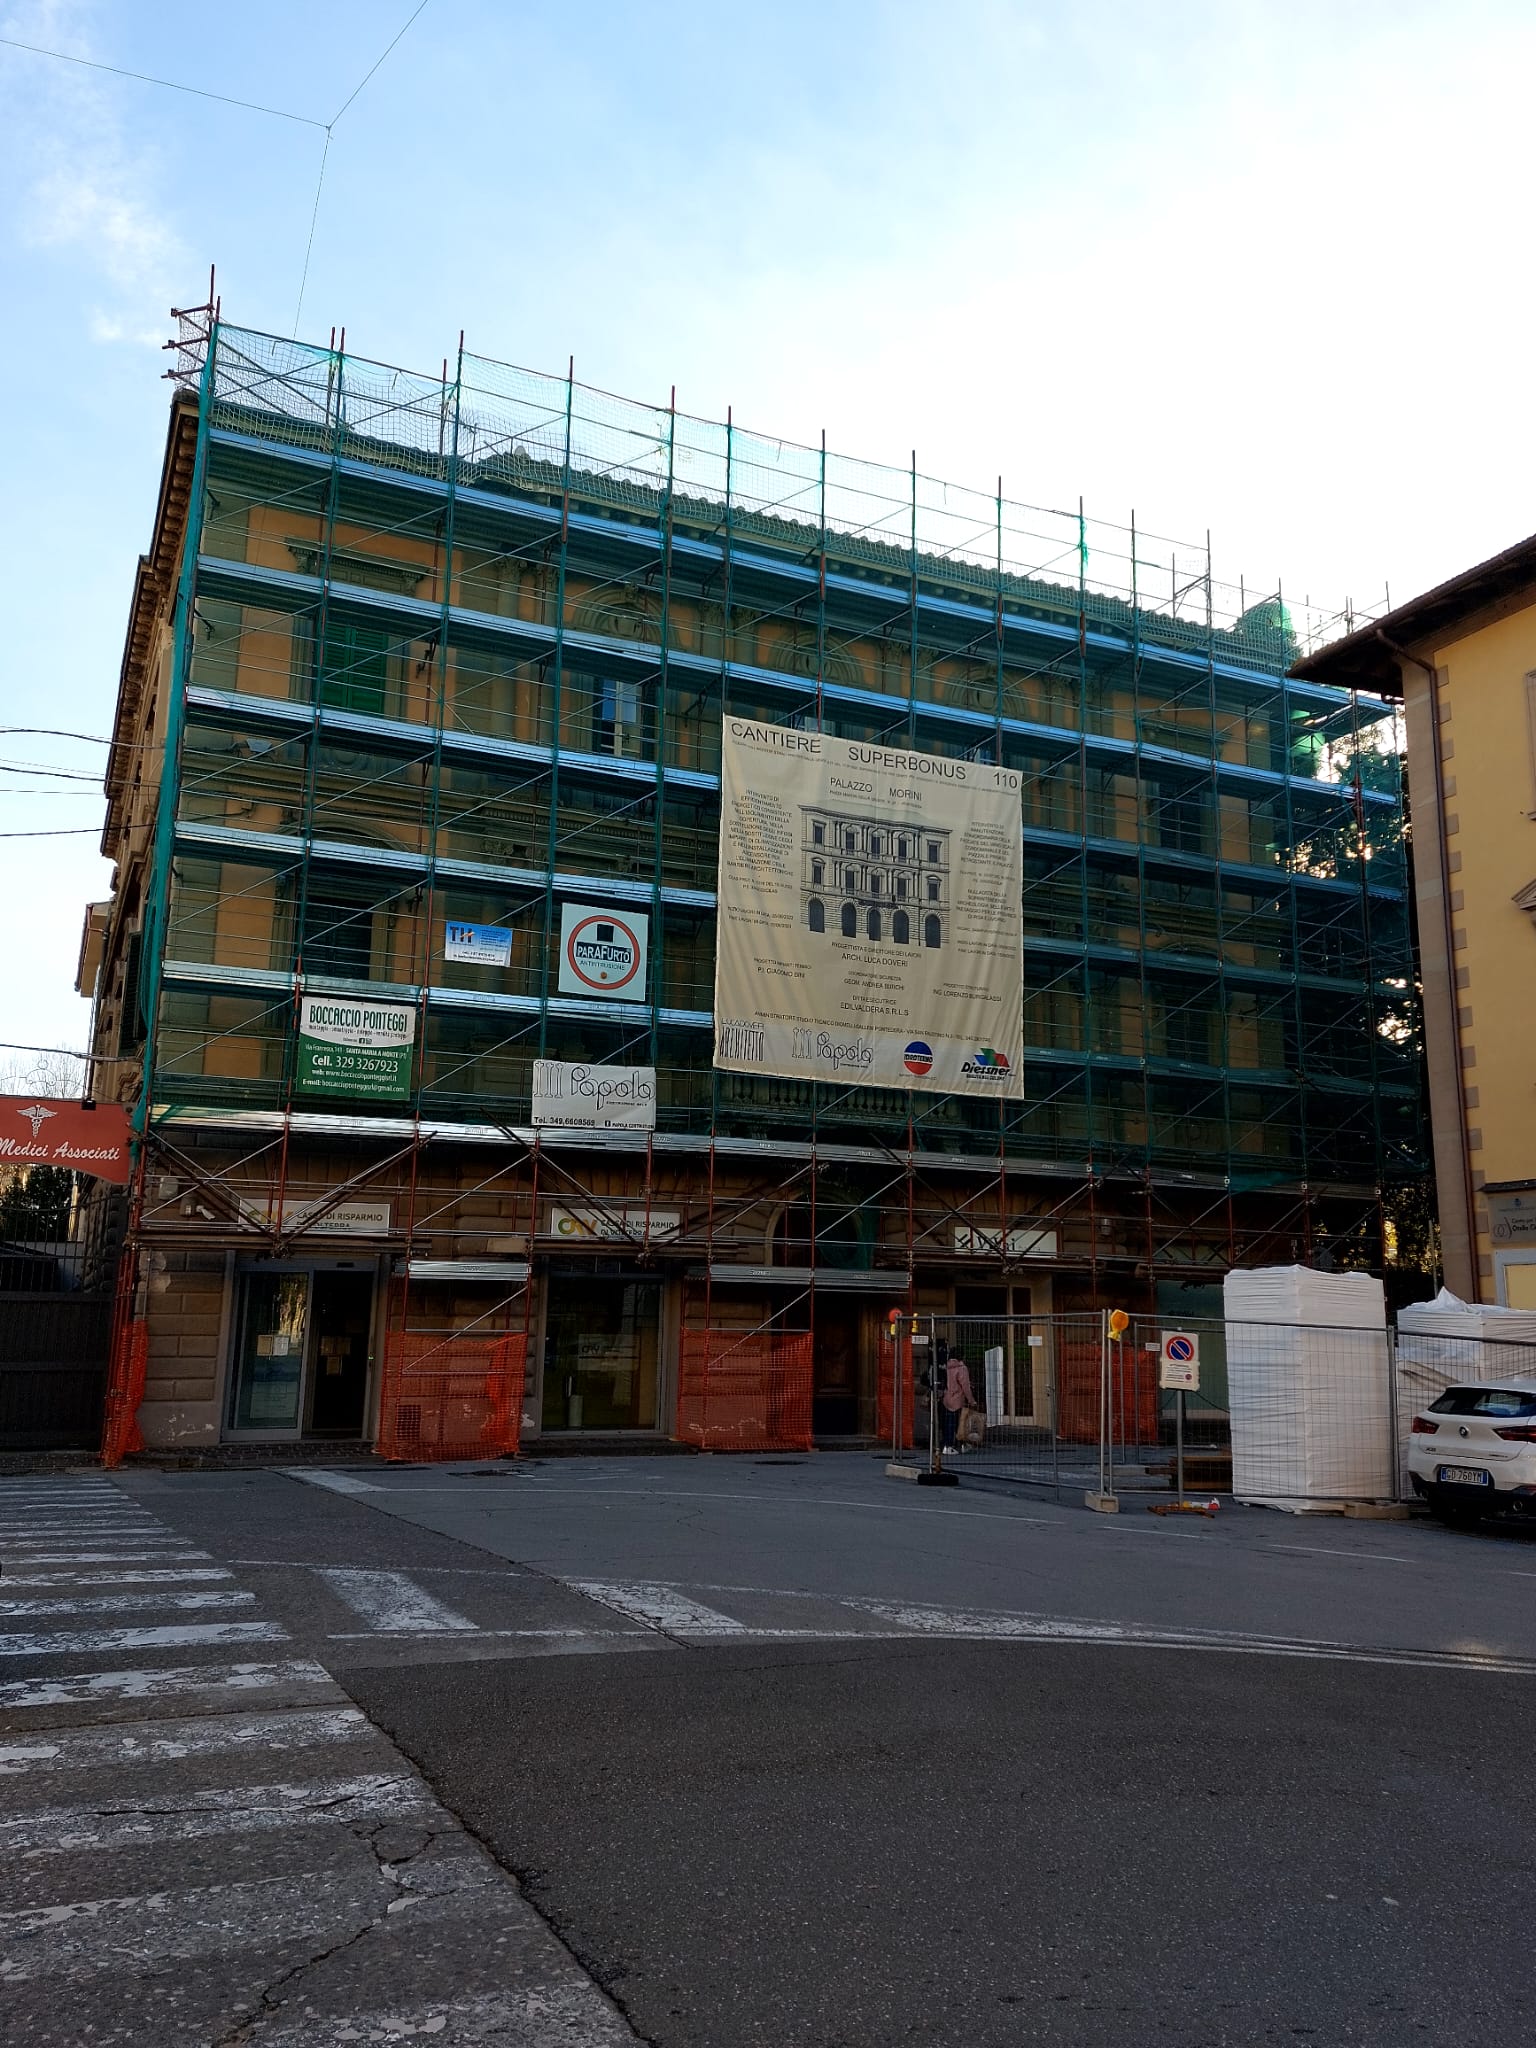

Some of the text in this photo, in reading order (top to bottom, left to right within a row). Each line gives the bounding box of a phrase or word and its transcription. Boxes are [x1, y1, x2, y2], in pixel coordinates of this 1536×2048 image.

[731, 722, 821, 754] CANTIERE
[848, 746, 966, 780] SUPERBONUS
[993, 772, 1018, 789] 110
[830, 777, 922, 801] PALAZZO MORINI
[577, 945, 630, 963] PARAFURTO
[864, 955, 881, 964] LUCA
[310, 1005, 408, 1032] BOCCACCIO PONTEGGI
[312, 1055, 398, 1072] Cell. 329 3267923
[961, 1061, 1011, 1076] Diessner
[571, 1065, 656, 1111] Papola
[0, 1137, 120, 1160] Medici Associati
[337, 1213, 383, 1222] RISPARMIO
